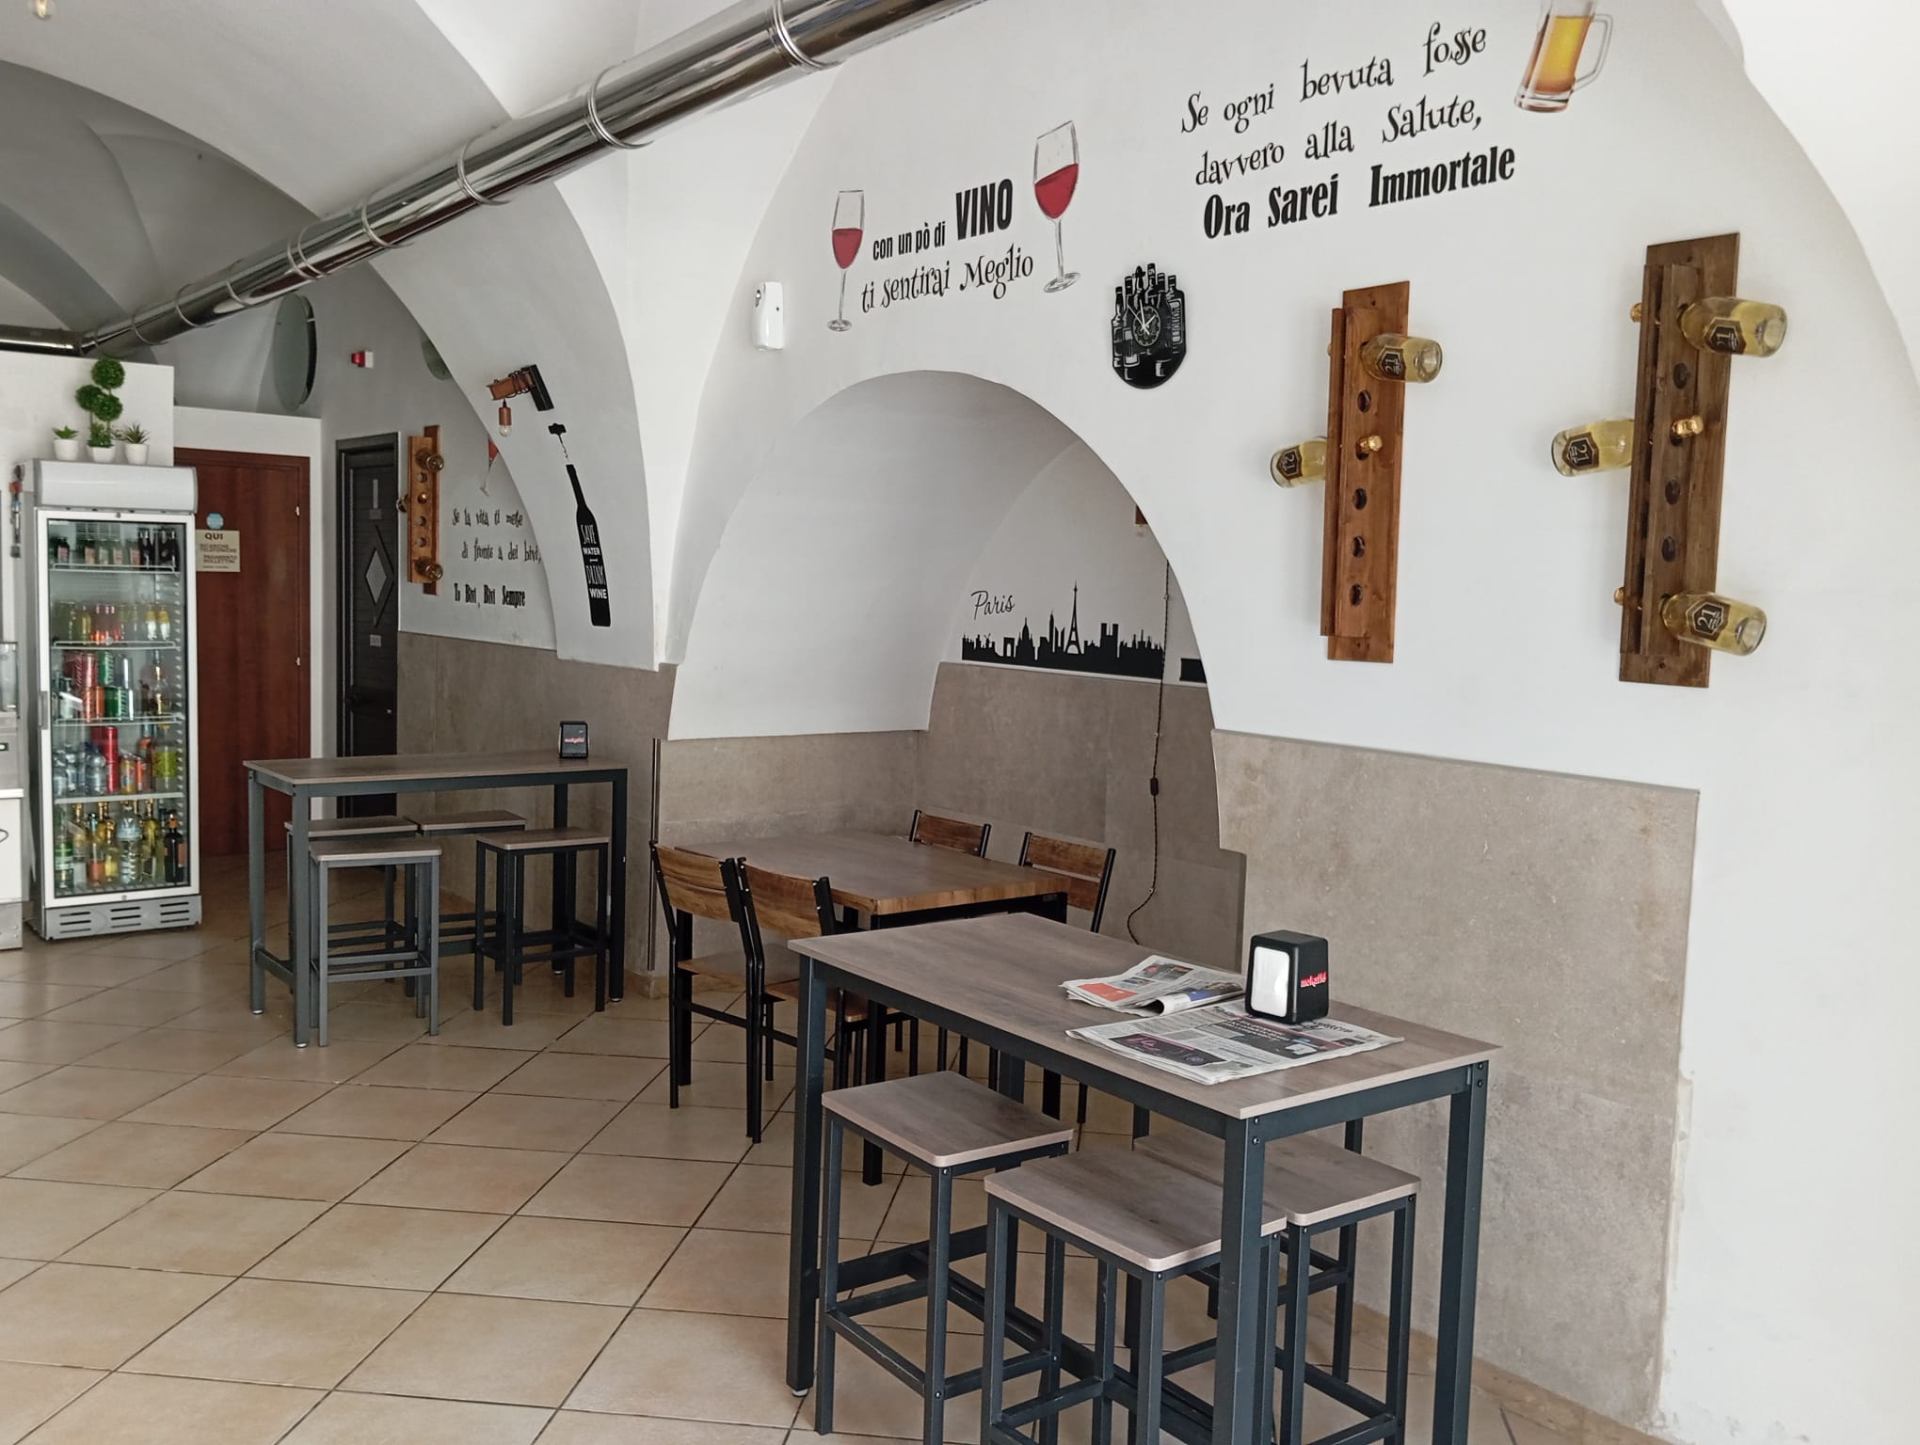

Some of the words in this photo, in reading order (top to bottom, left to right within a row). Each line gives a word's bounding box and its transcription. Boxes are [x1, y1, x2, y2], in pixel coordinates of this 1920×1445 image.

[1181, 91, 1209, 134] Se
[1223, 83, 1275, 134] ogni
[1300, 56, 1395, 102] bevuta
[1422, 21, 1487, 78] fosse
[1195, 141, 1285, 186] davvero
[1304, 120, 1355, 161] alla
[1381, 94, 1482, 144] Salute,
[872, 236, 894, 261] con
[898, 231, 913, 256] un
[915, 221, 931, 254] pò
[934, 220, 947, 248] di
[955, 178, 1014, 241] VINO
[1203, 194, 1251, 239] Ora
[1267, 173, 1339, 228] Sarei
[1368, 146, 1516, 207] Immortale
[861, 281, 876, 314] ti
[959, 243, 1034, 300] Meglio
[205, 532, 223, 541] QUI
[589, 588, 607, 599] WINE
[970, 590, 1016, 620] Paris
